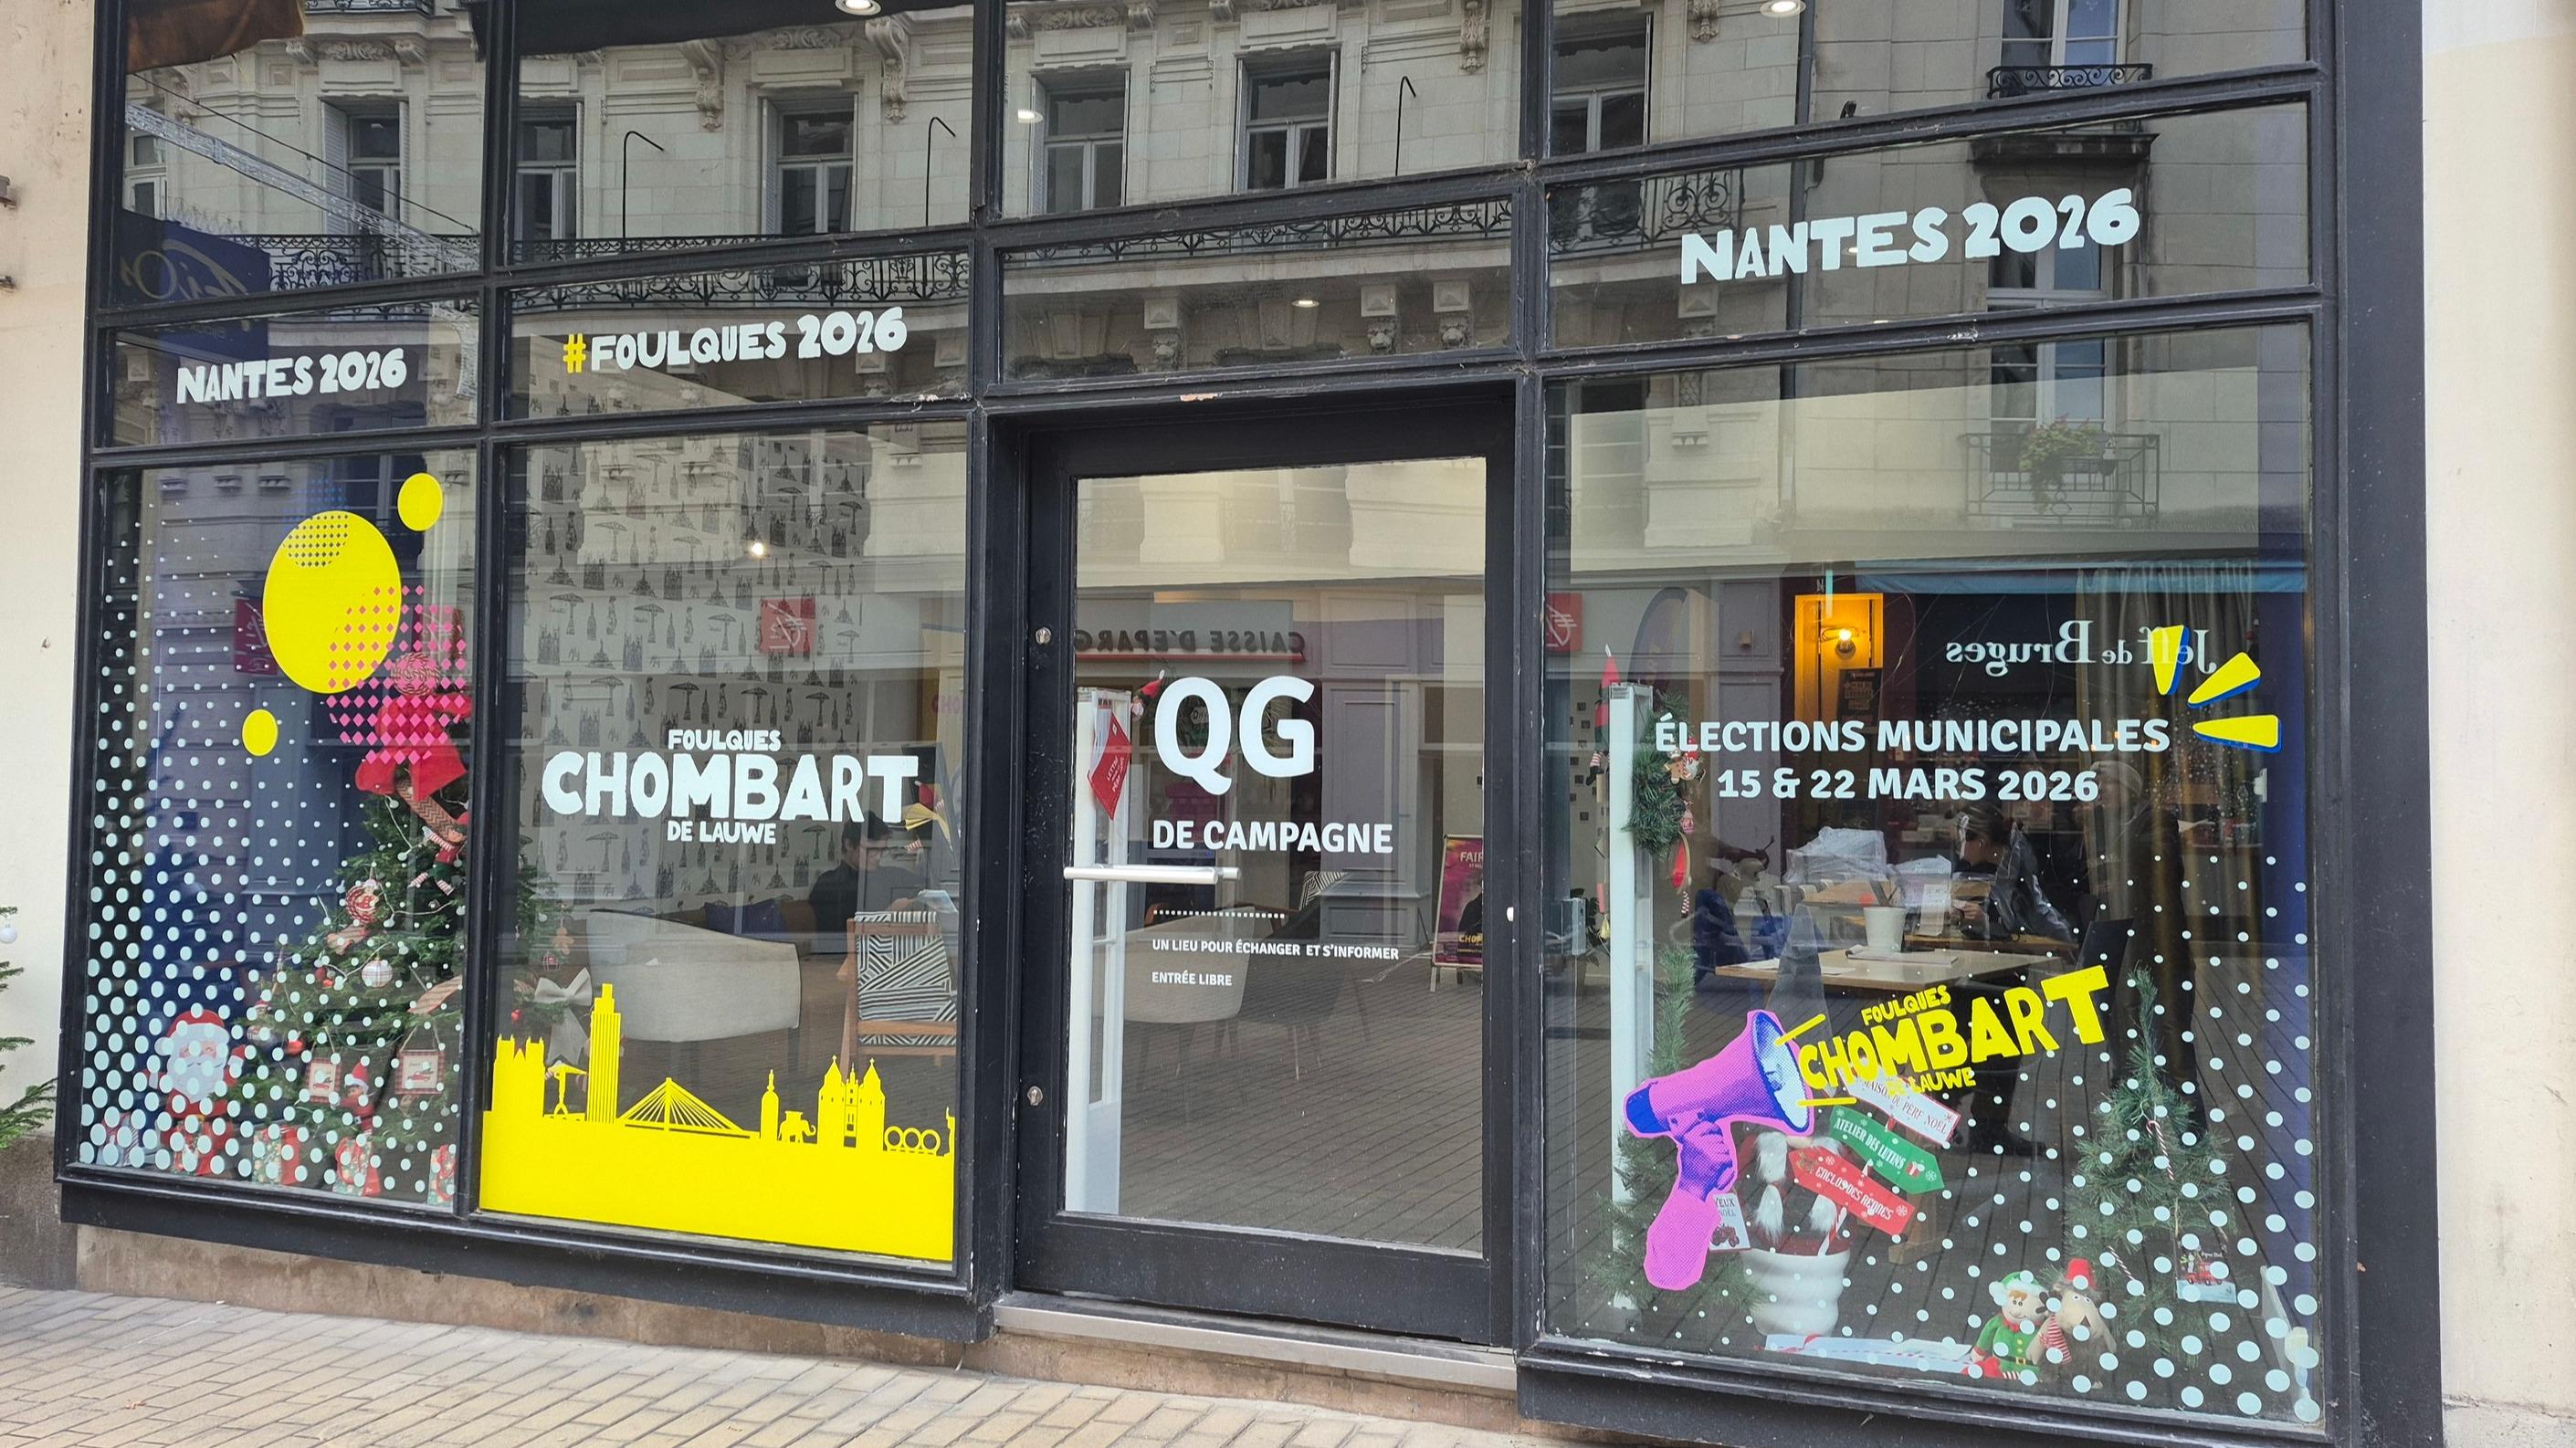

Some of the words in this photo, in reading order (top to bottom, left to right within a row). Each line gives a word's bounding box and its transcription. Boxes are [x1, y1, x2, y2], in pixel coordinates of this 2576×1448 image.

[1680, 206, 1949, 286] NANTES
[1961, 187, 2140, 259] 2026
[562, 320, 787, 374] #FOULQUES
[796, 306, 909, 359] 2026
[175, 353, 313, 404] NANTES
[319, 348, 407, 393] 2026
[668, 729, 783, 752] FOULQUES
[1153, 675, 1316, 795] QG
[1655, 711, 1866, 753] ÉLECTIONS
[1877, 719, 2171, 753] MUNICIPALES
[541, 750, 920, 824] CHOMBART
[1717, 769, 1761, 799] 15
[1772, 767, 1802, 800] &
[1810, 769, 1856, 800] 22
[1867, 768, 1986, 801] MARS
[1997, 769, 2099, 802] 2026
[667, 820, 694, 842] DE
[699, 821, 777, 845] LAUWE
[1152, 819, 1194, 850] DE
[1203, 820, 1394, 855] CAMPAGNE
[1151, 939, 1170, 951] UN
[1172, 939, 1198, 952] LIEU
[1201, 940, 1234, 954] POUR
[1235, 939, 1301, 957] ÉCHANGER
[1306, 944, 1321, 958] ET
[1322, 944, 1400, 960] S'INFORMER
[1151, 970, 1196, 985] ENTRÉE
[1198, 973, 1233, 987] LIBRE
[1860, 984, 1952, 1027] FOULQUES
[1797, 964, 2110, 1090] CHOMBART
[1862, 1080, 1889, 1100] MAISO
[1907, 1065, 1977, 1094] LAUWE
[1834, 1117, 1868, 1143] ATELIER
[1865, 1133, 1881, 1154] DES
[1877, 1143, 1907, 1170] LUTINS
[1845, 1182, 1864, 1201] DES
